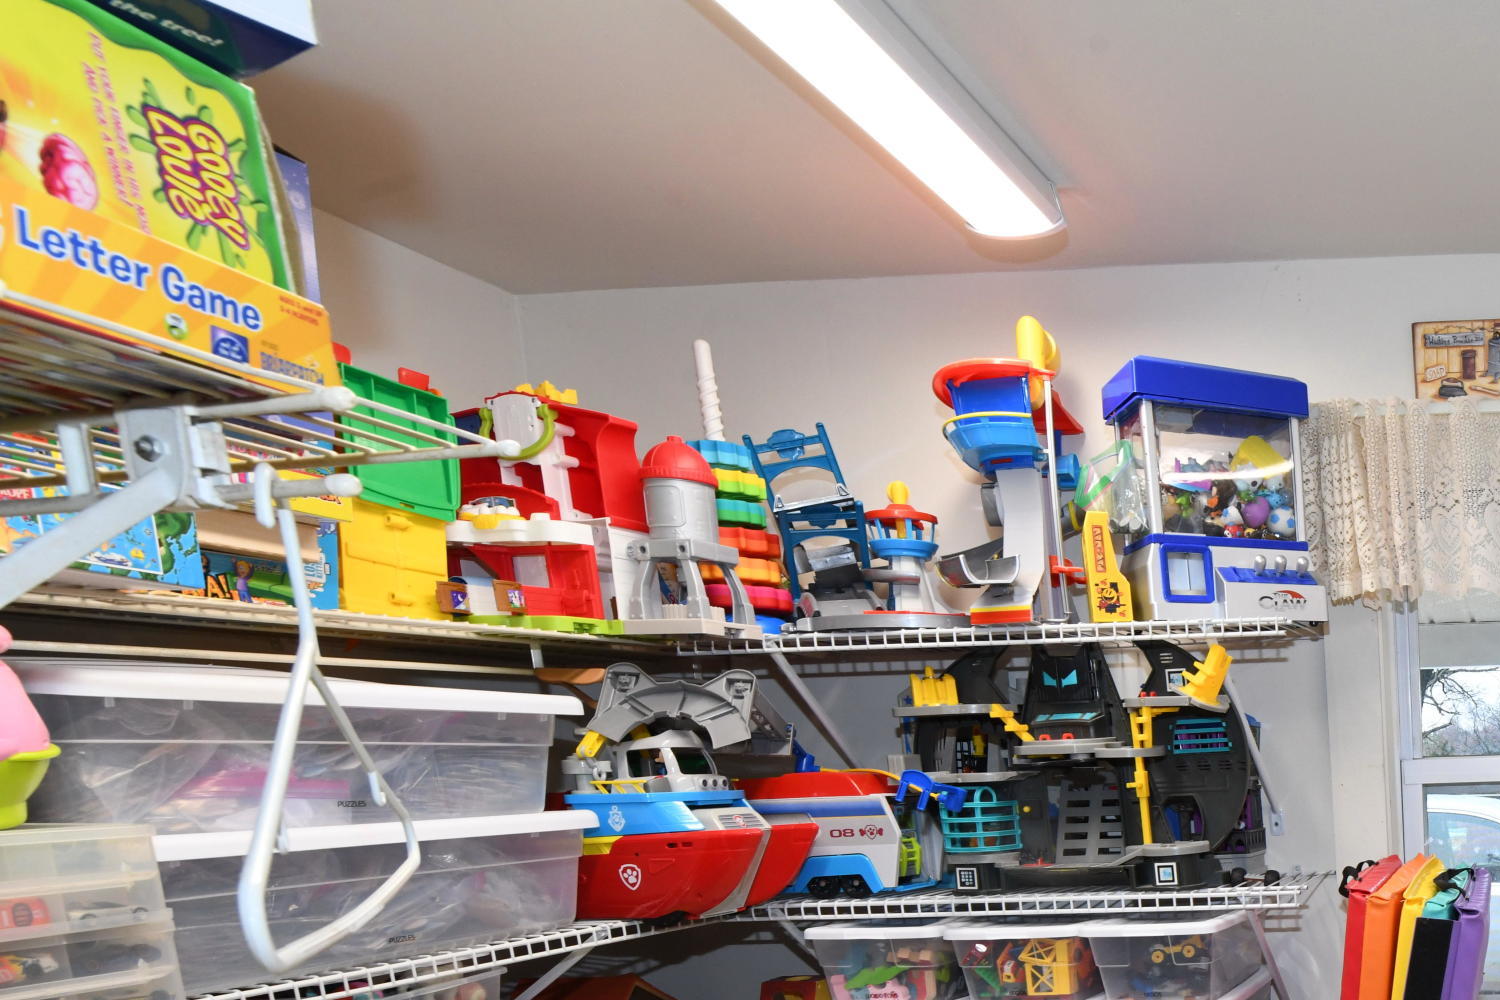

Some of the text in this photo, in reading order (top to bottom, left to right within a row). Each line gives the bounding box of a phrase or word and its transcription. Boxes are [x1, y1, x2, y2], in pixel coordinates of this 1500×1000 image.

[159, 15, 224, 47] tree!
[15, 206, 261, 331] Letter Game
[337, 800, 367, 808] PUZZLES
[829, 828, 855, 838] 08
